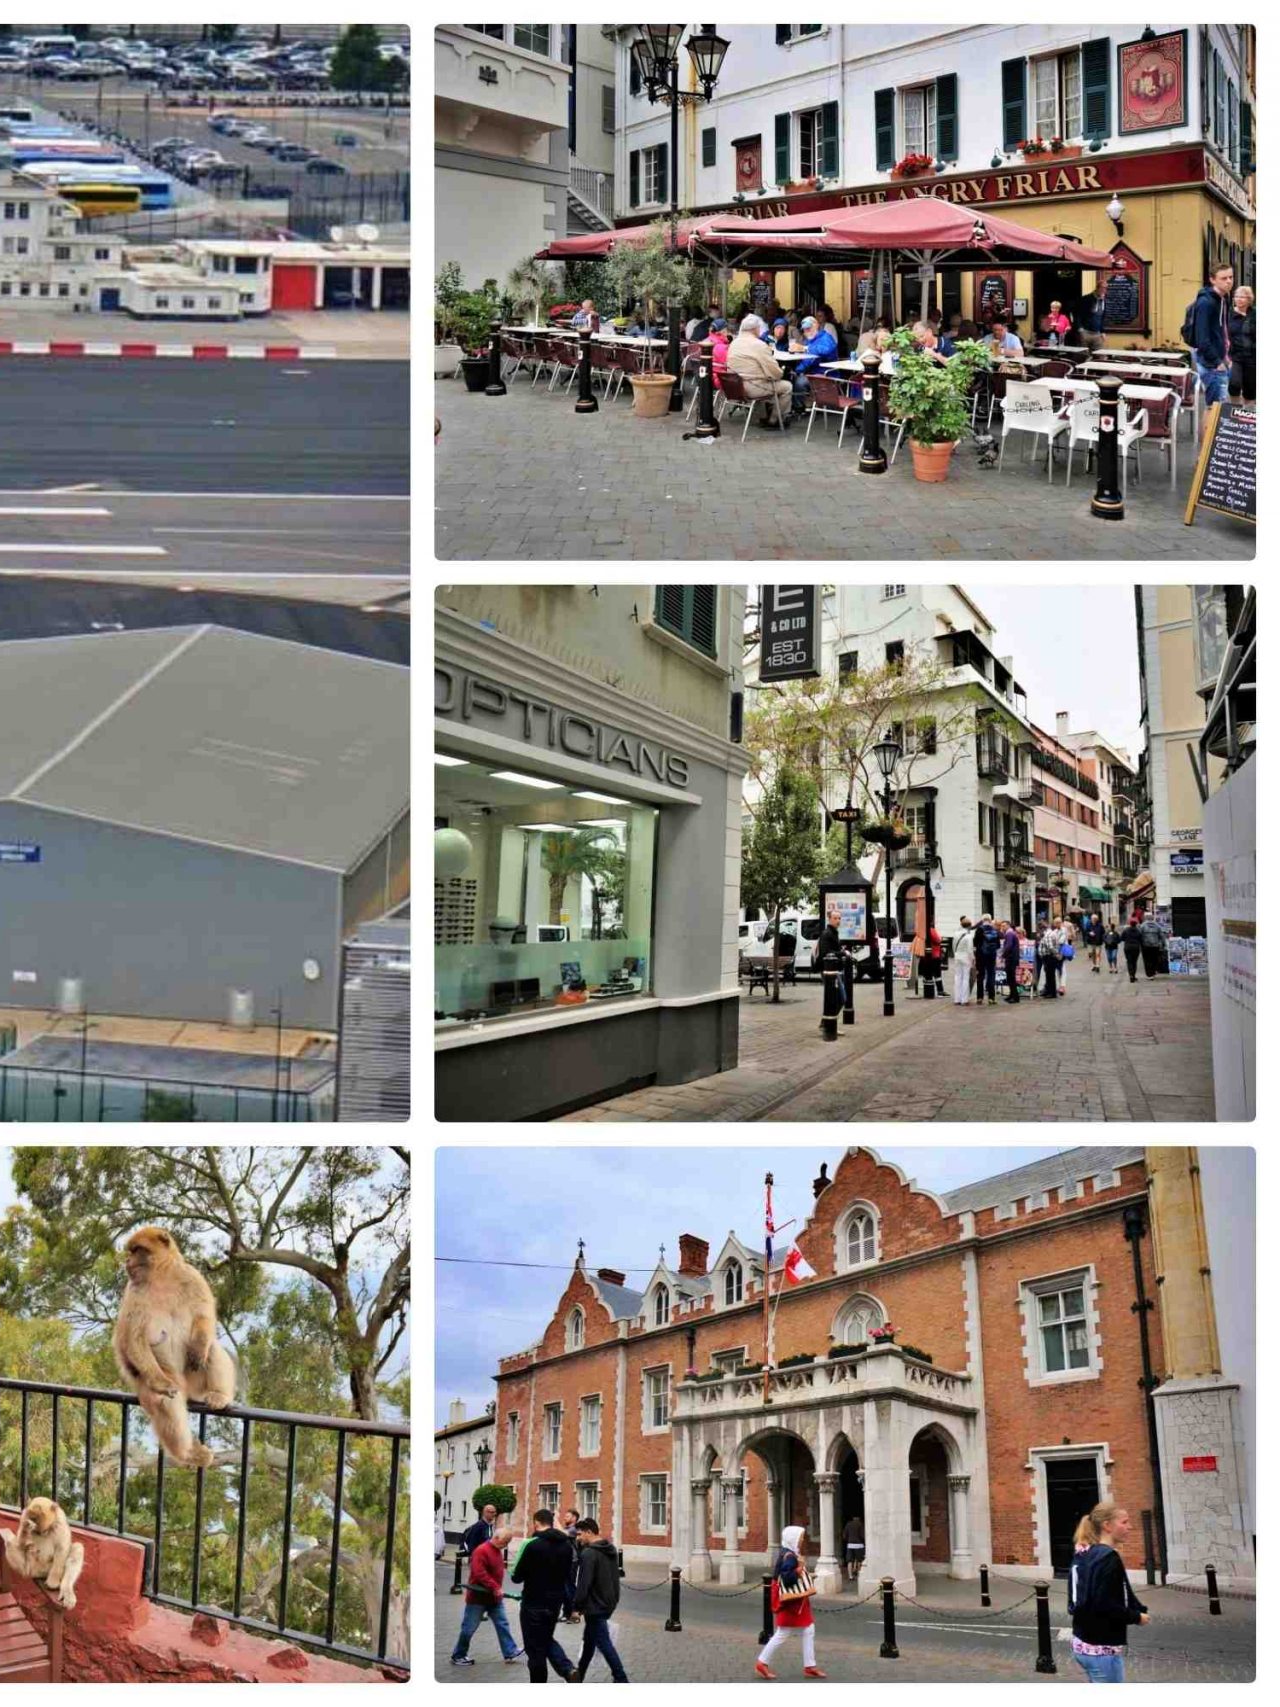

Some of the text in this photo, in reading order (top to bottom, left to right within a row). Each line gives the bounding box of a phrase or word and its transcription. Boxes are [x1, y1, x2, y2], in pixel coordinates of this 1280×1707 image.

[842, 190, 887, 208] THE
[996, 166, 1102, 199] FRIAR
[773, 585, 805, 612] E
[779, 618, 790, 631] CO
[791, 616, 807, 630] LTD
[772, 638, 805, 654] EST
[765, 651, 807, 667] 1830
